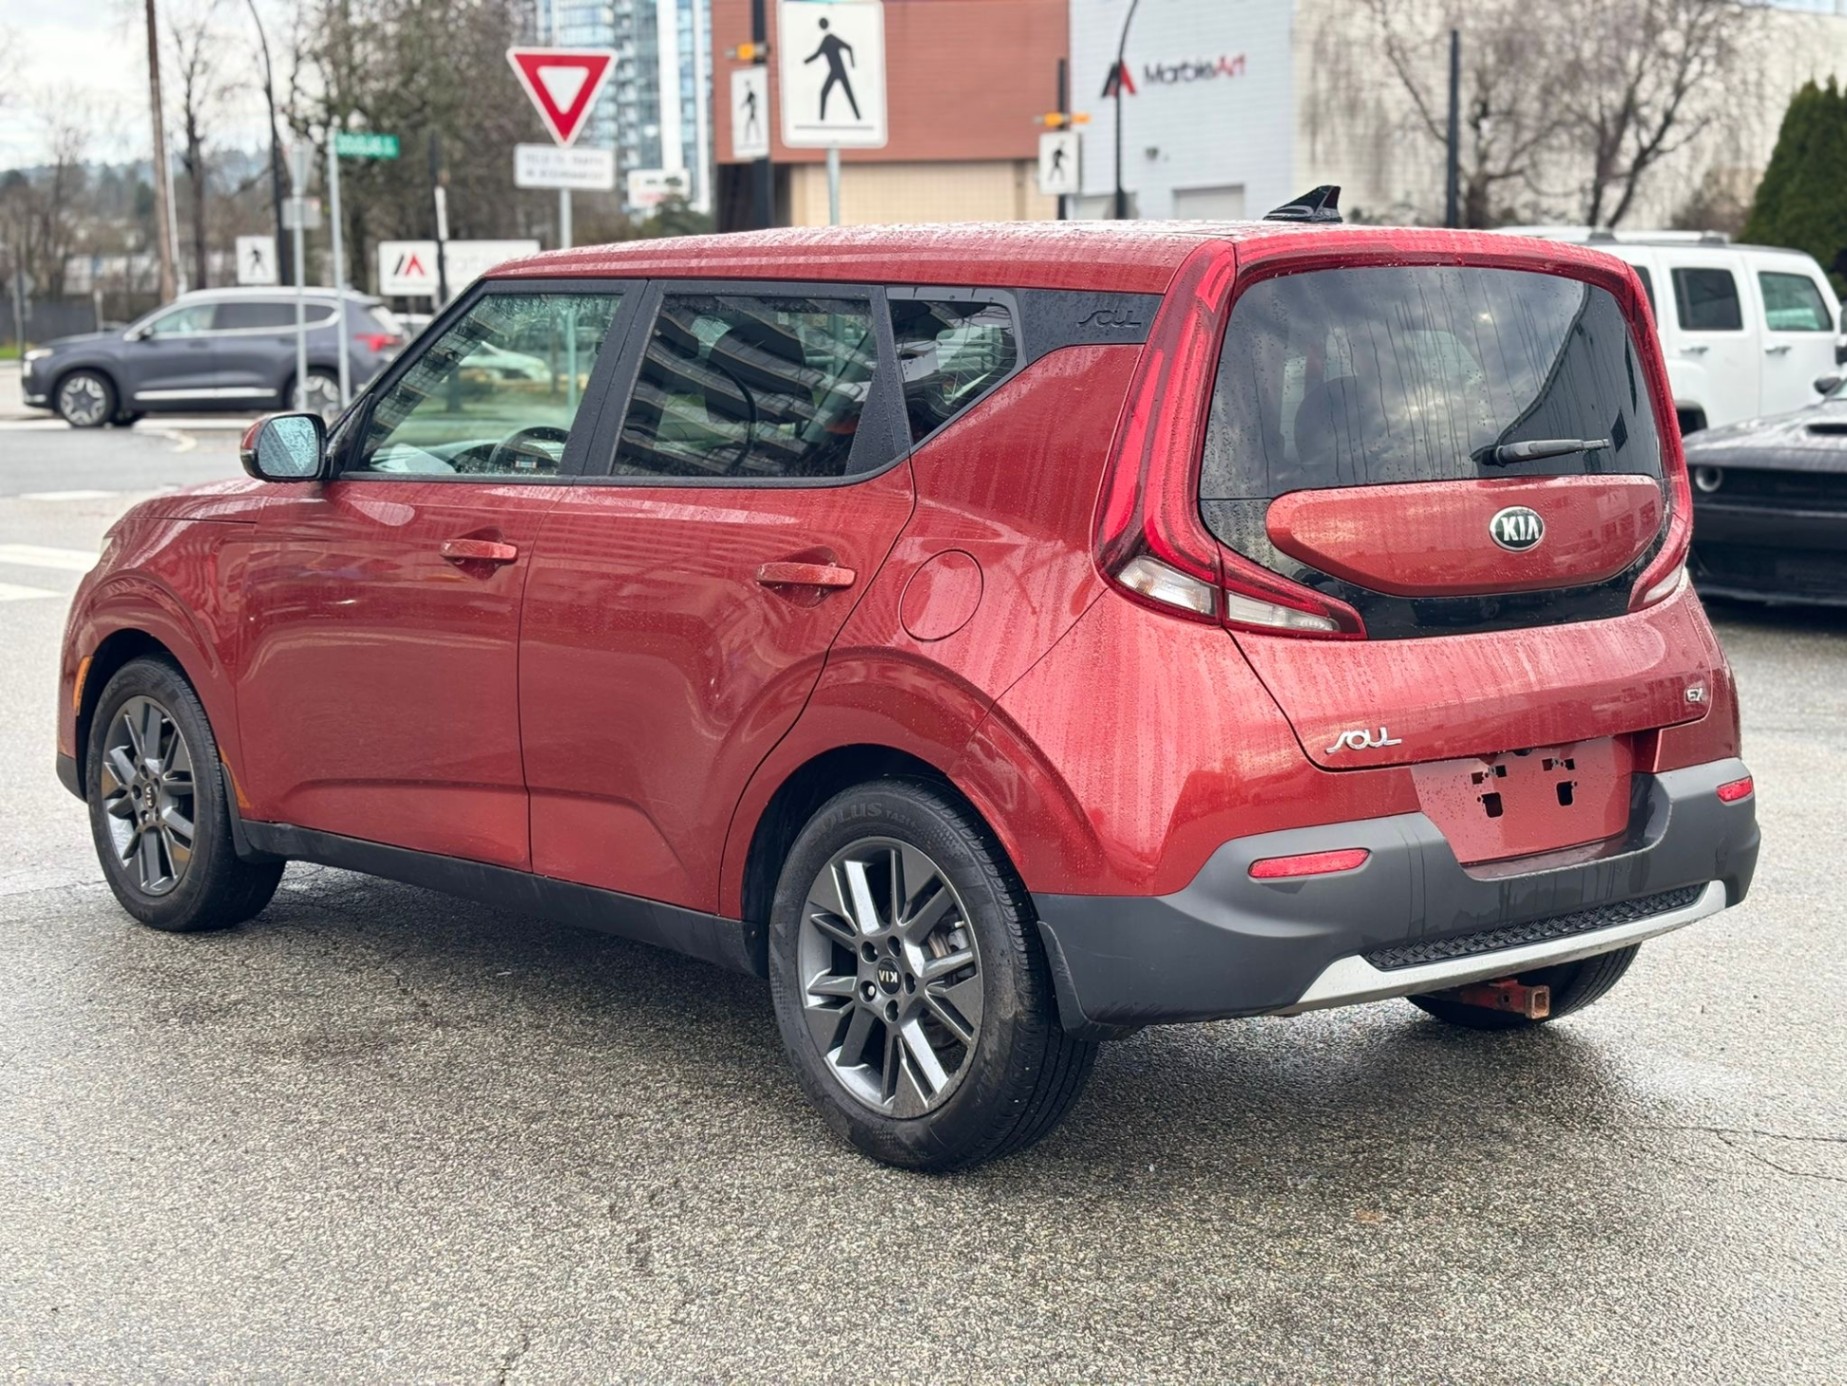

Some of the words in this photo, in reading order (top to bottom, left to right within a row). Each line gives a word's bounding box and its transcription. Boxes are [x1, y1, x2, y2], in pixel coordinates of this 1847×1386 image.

[1076, 309, 1141, 328] SOUL
[1501, 515, 1540, 541] KIA
[1325, 727, 1402, 754] SOUL
[879, 969, 899, 983] KIA
